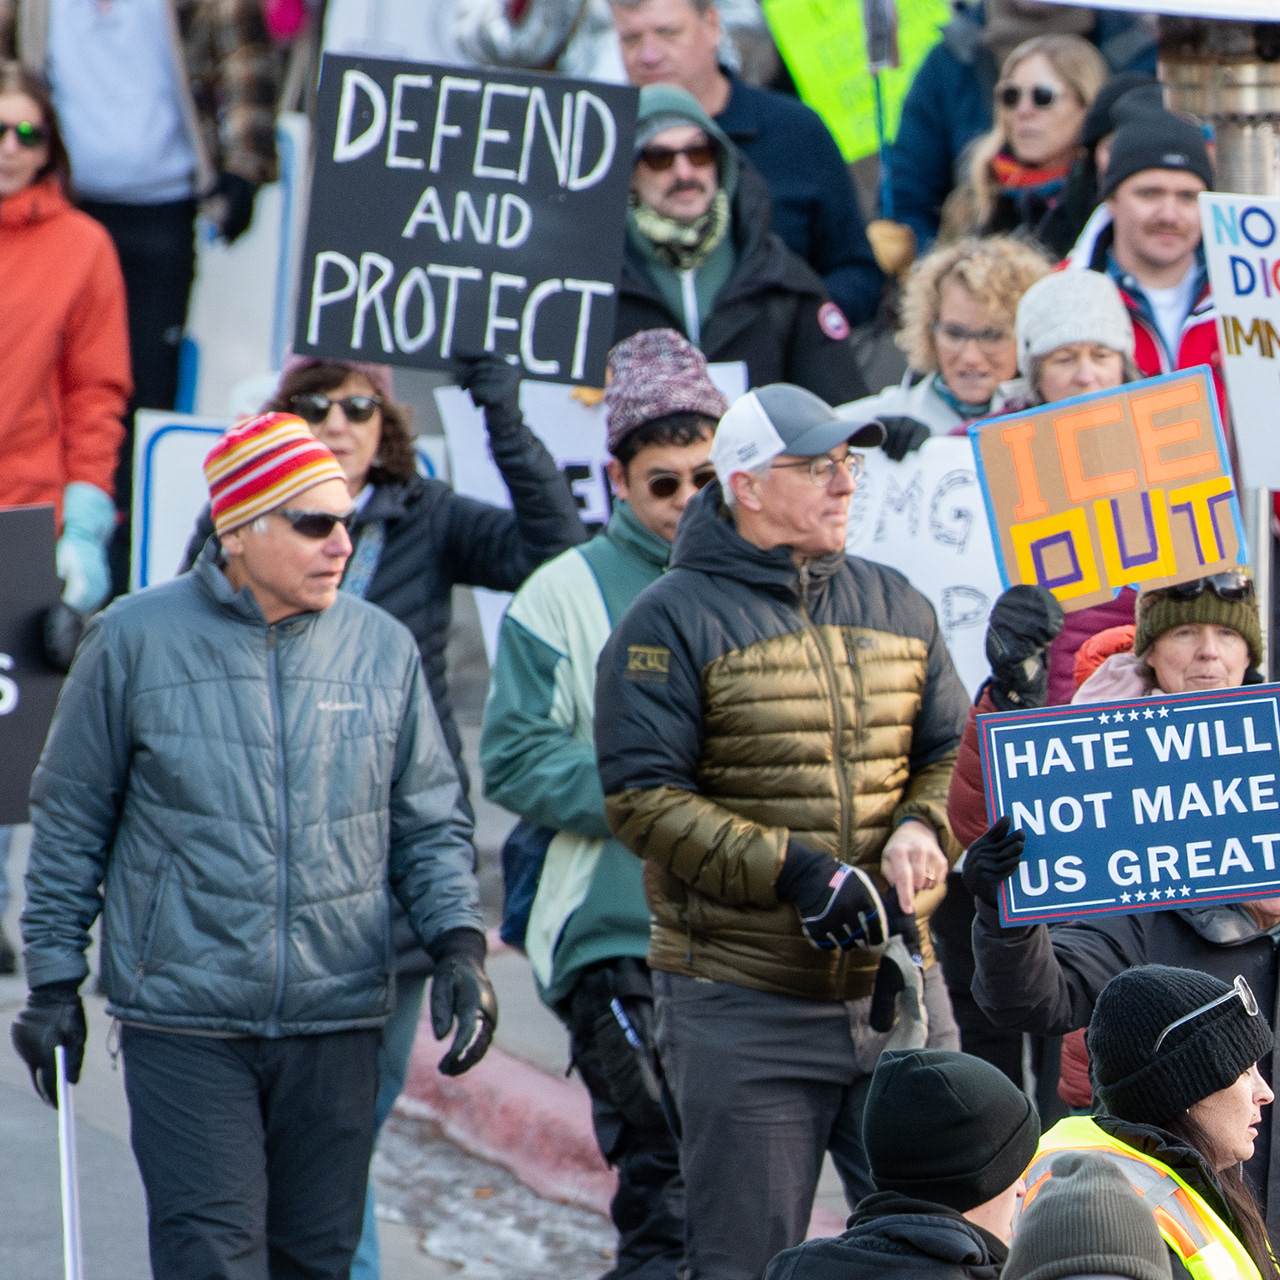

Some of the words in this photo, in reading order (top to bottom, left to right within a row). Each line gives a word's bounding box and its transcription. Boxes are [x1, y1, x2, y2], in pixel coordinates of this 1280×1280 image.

[333, 69, 617, 191] DEFEND
[401, 186, 532, 249] AND
[1213, 204, 1277, 248] NO
[307, 251, 615, 380] PROTECT
[1001, 382, 1218, 522] ICE
[1009, 475, 1240, 602] OUT
[1003, 728, 1134, 779] HATE
[1145, 715, 1273, 764] WILL
[1010, 790, 1113, 840] NOT
[1132, 773, 1280, 825] MAKE
[1017, 856, 1087, 897] US
